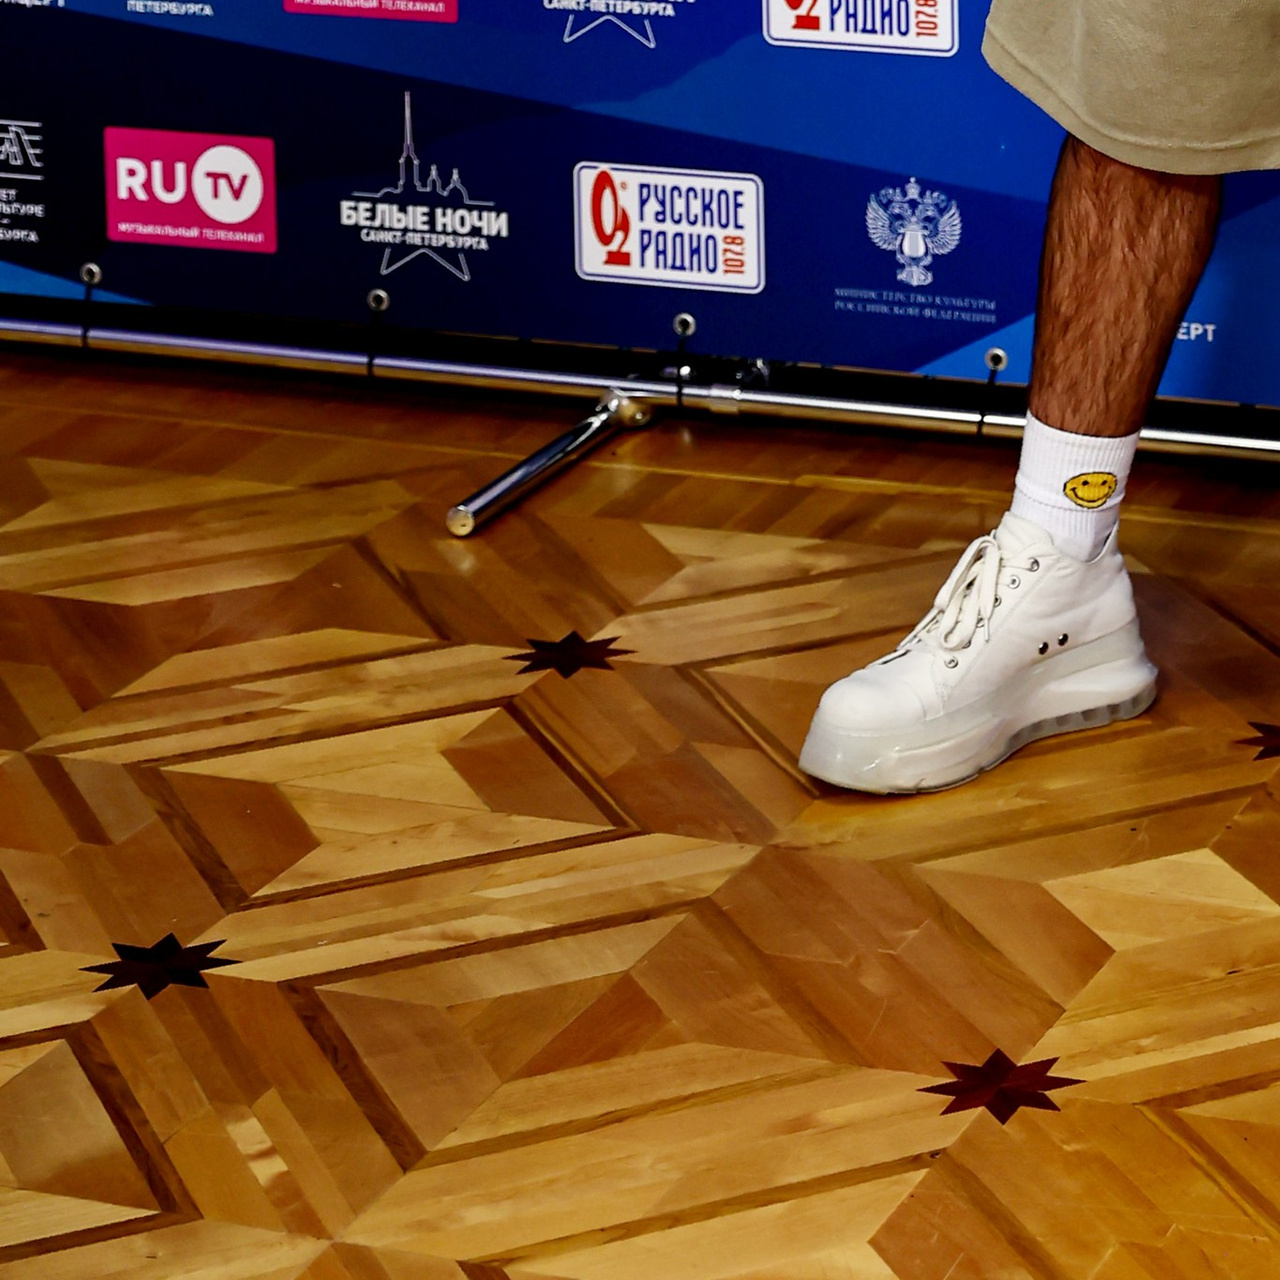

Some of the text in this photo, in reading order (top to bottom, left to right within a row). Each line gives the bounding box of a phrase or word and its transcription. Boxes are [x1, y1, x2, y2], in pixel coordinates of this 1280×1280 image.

[116, 156, 249, 205] RU TV
[340, 199, 508, 238] БЕЛЫЕ НОЧИ
[637, 183, 744, 230] РУССКОЕ
[639, 229, 717, 273] РАДИО
